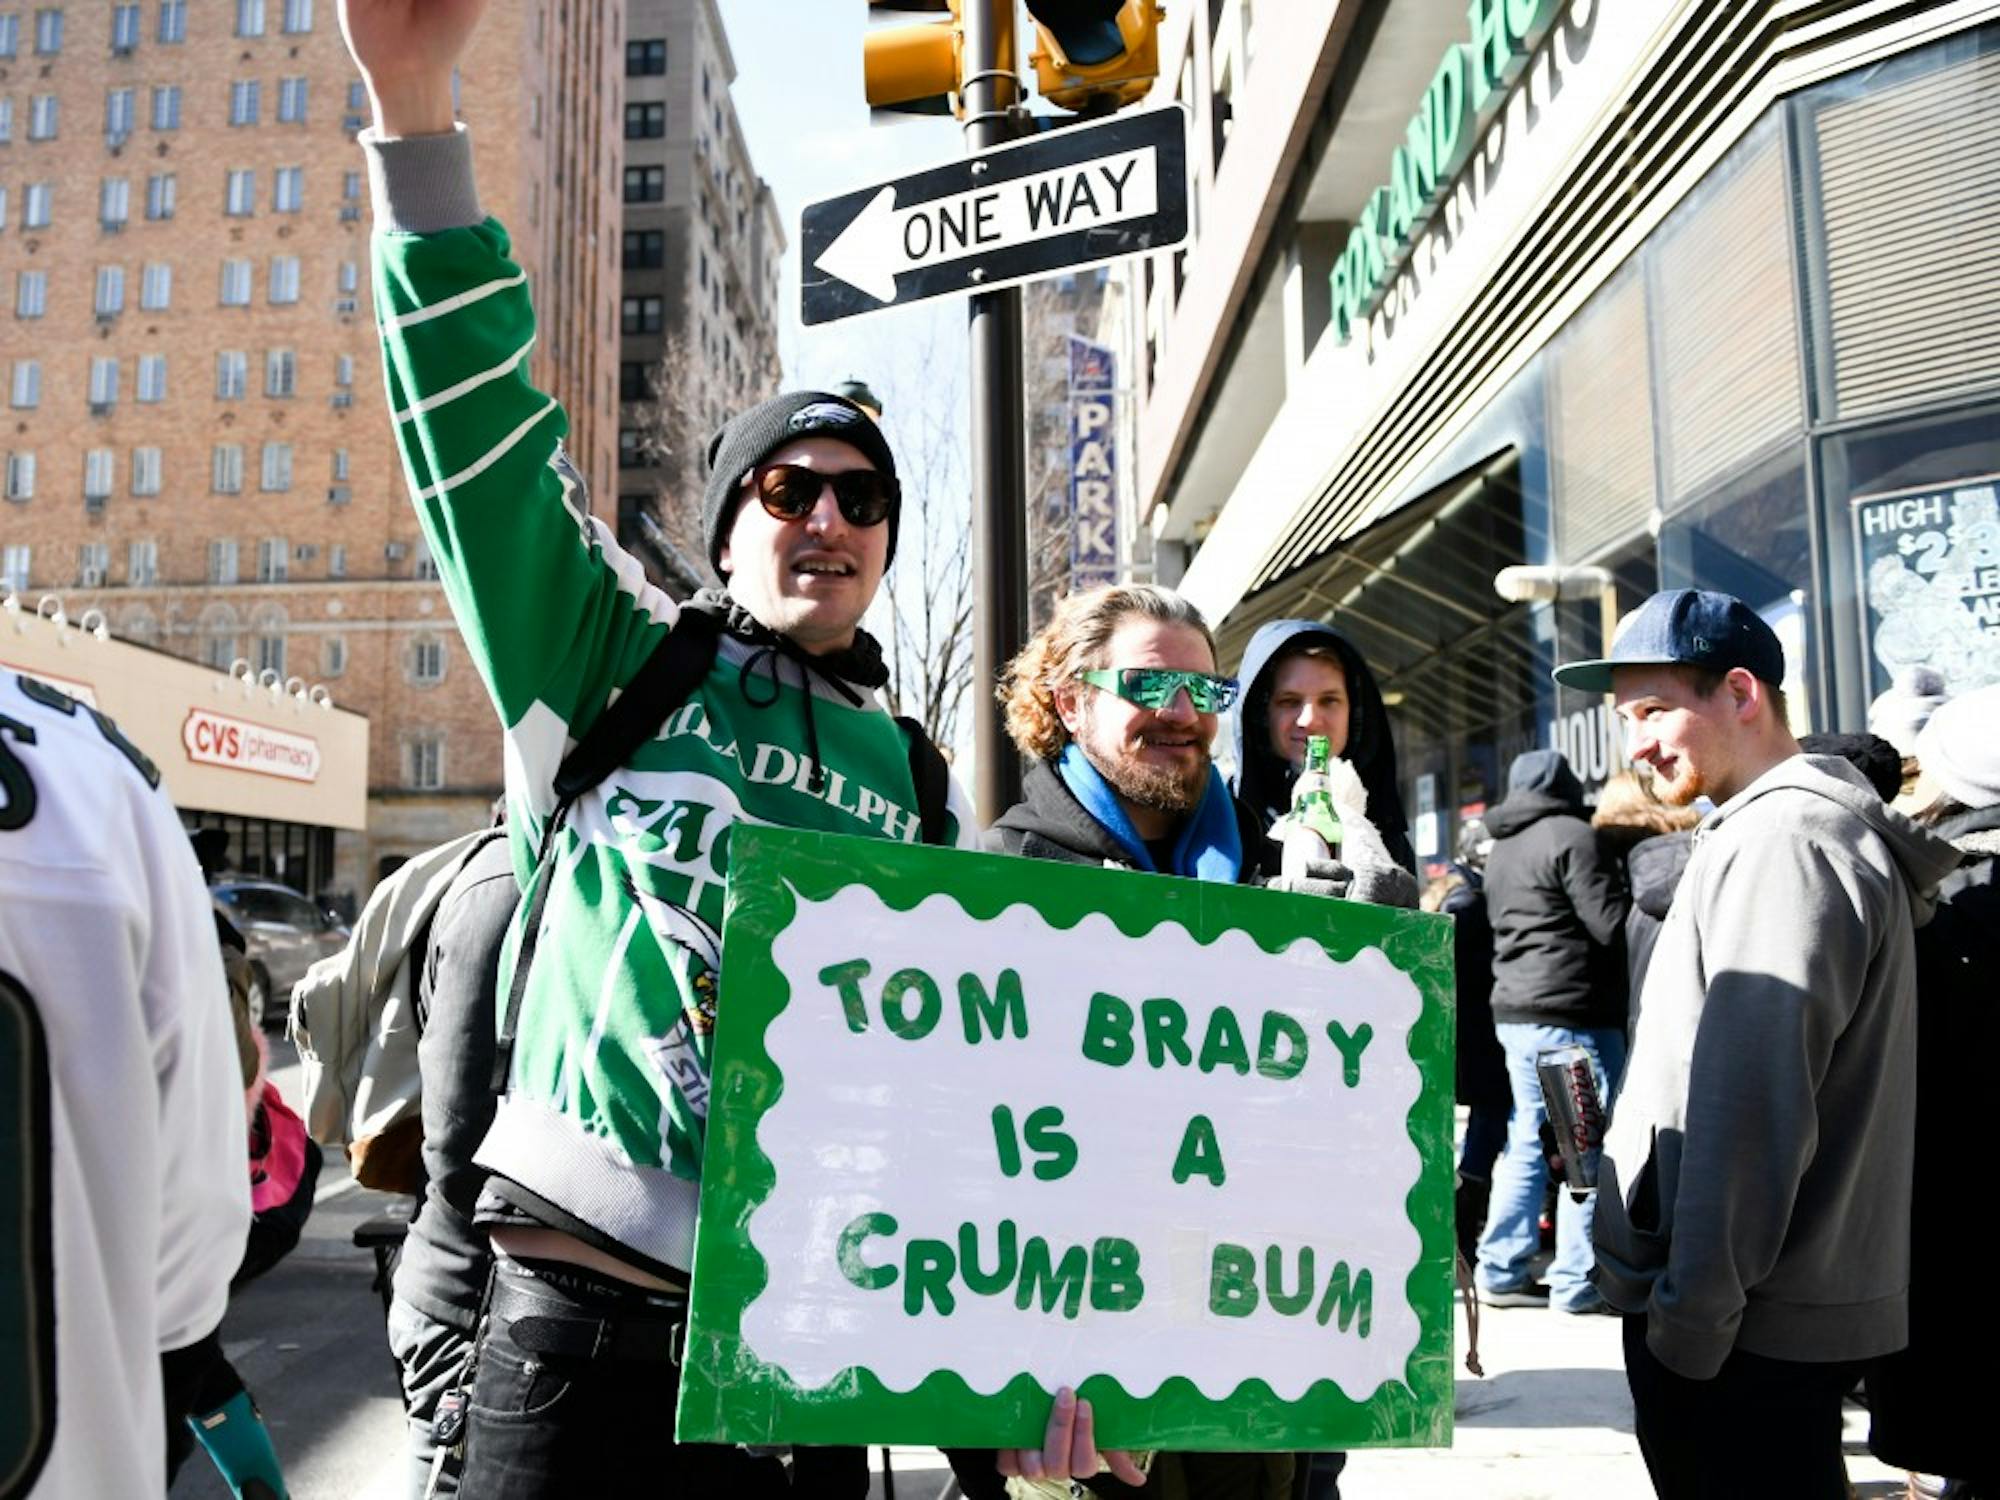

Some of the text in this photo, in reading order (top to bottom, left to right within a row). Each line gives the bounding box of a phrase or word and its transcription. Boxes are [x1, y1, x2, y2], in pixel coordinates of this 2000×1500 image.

[904, 159, 1137, 260] ONE WAY
[1330, 187, 1385, 346] FOX
[1389, 43, 1464, 248] AND
[1074, 402, 1113, 556] PARK
[1863, 496, 1943, 536] HIGH
[196, 720, 239, 759] CVS
[1549, 703, 1632, 783] HOUN
[819, 959, 1373, 1088] TOM BRADY
[992, 1105, 1225, 1186] IS A
[838, 1213, 1372, 1338] CRUMB BUM
